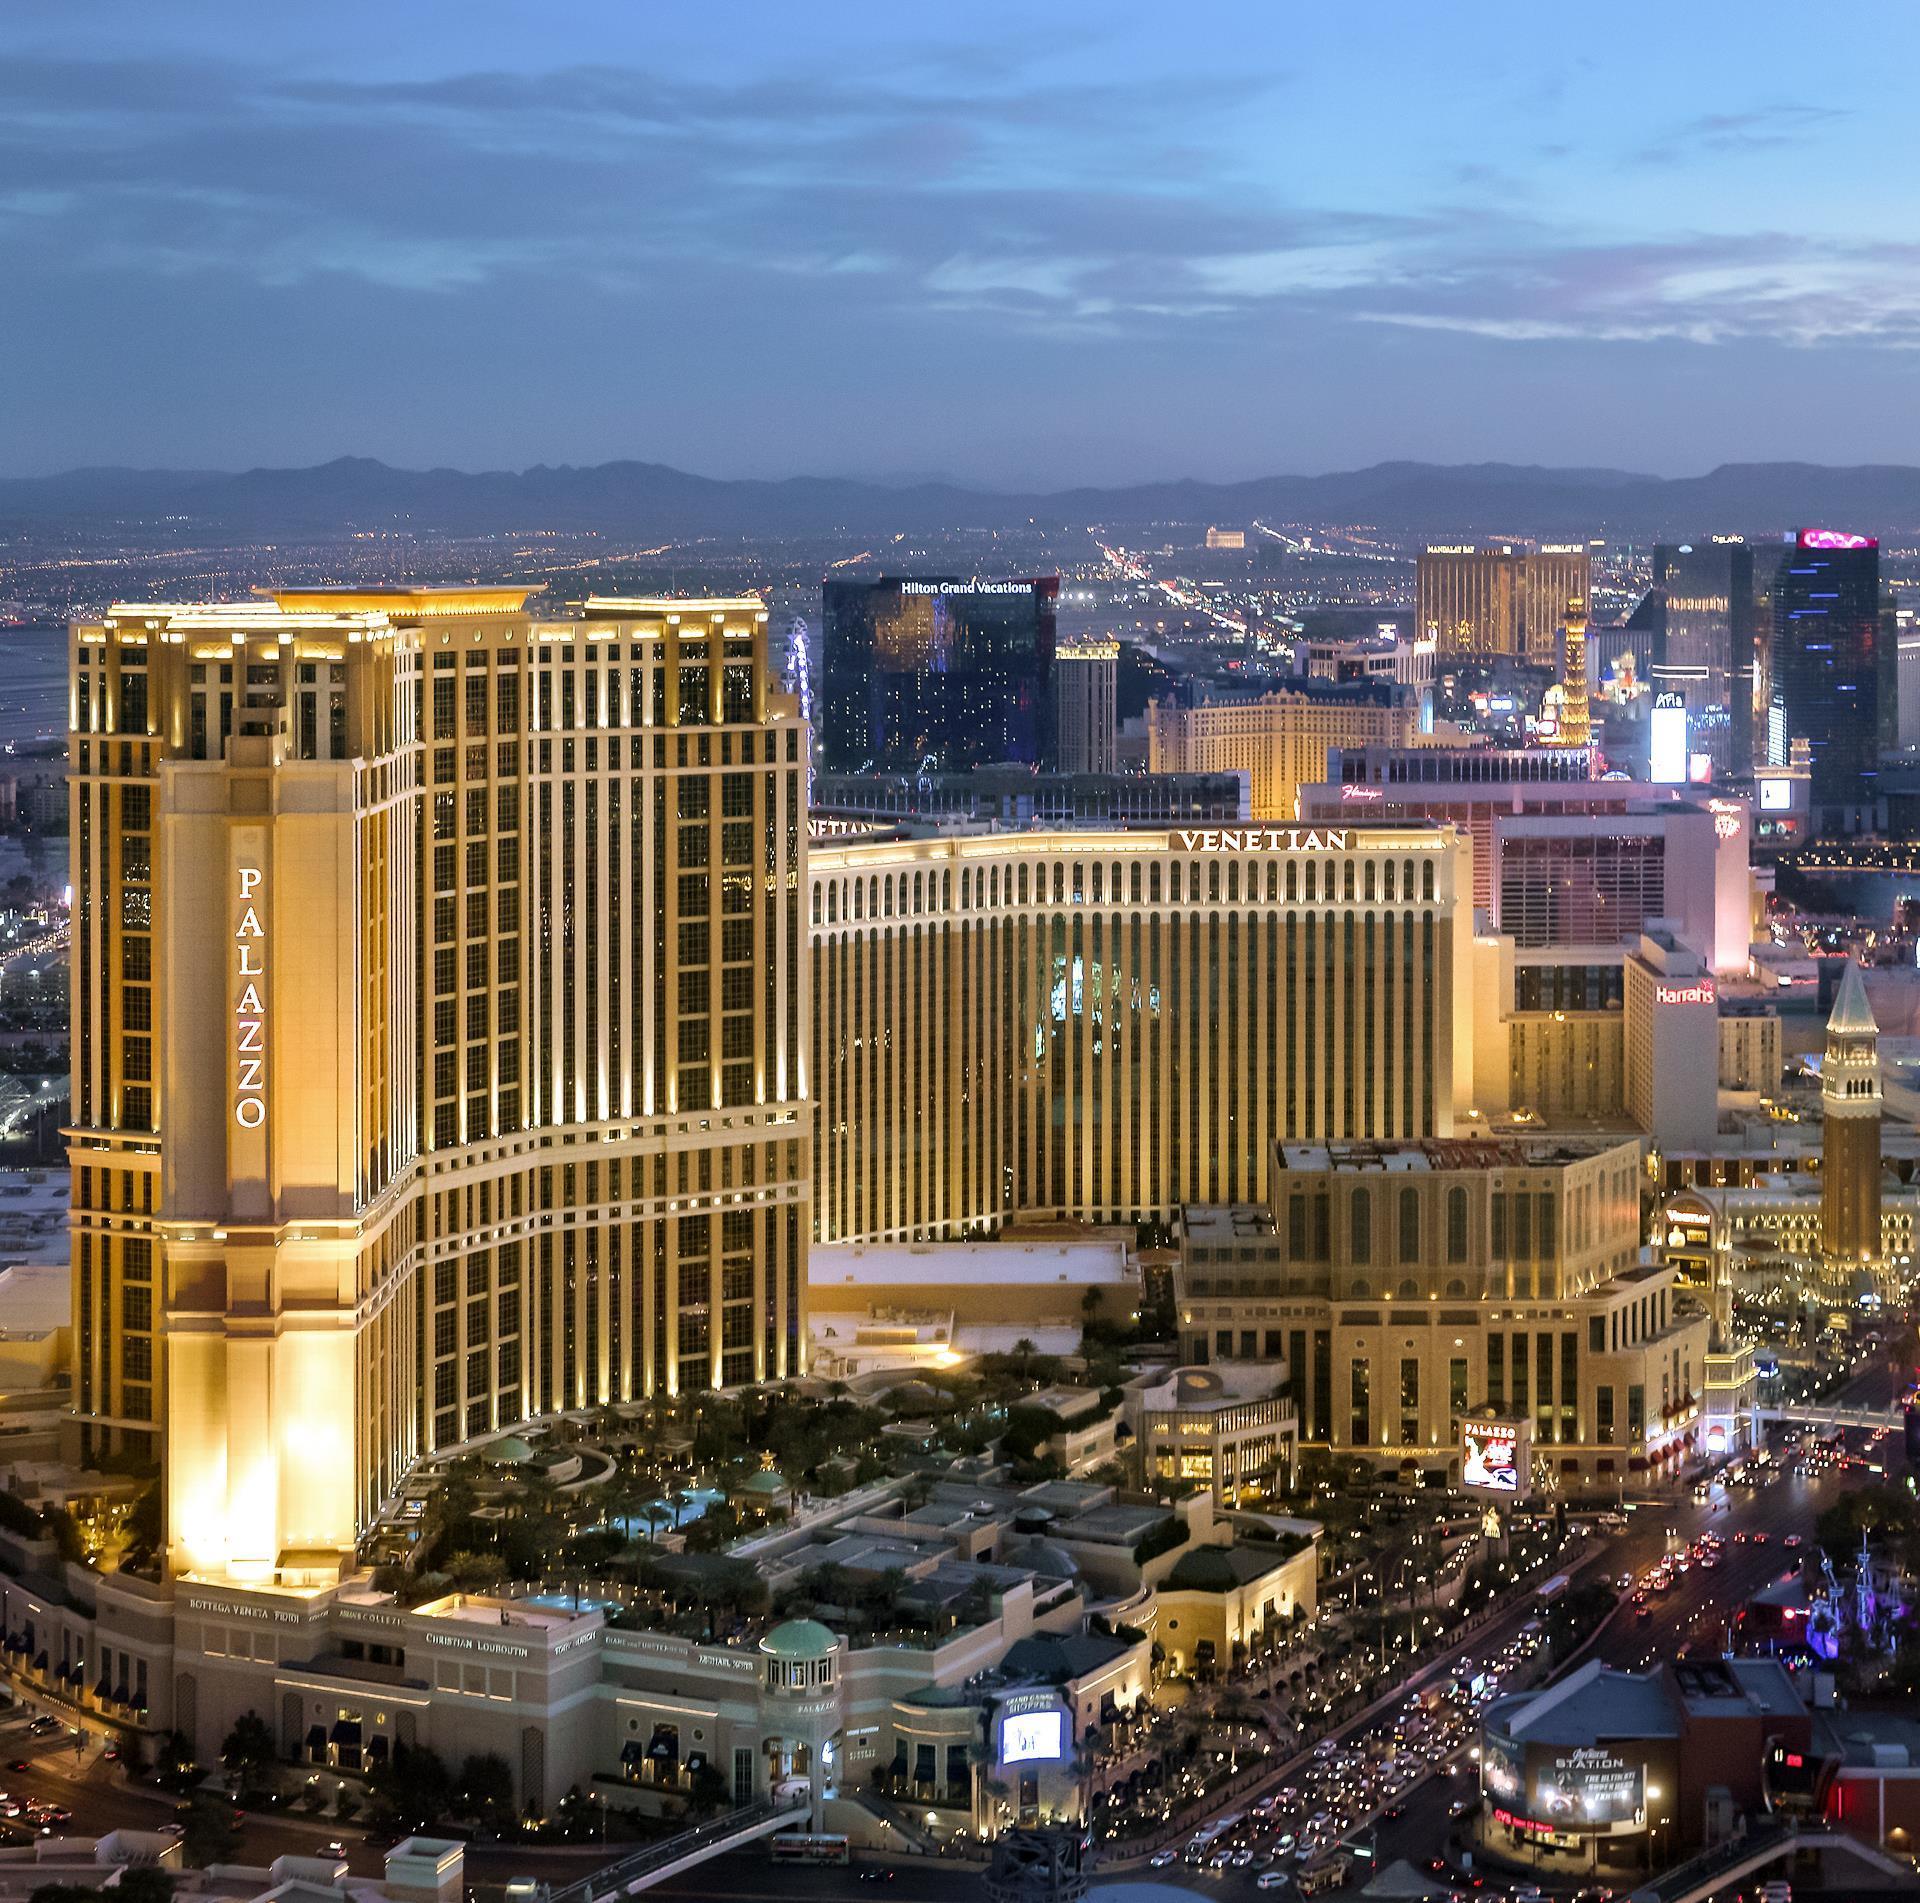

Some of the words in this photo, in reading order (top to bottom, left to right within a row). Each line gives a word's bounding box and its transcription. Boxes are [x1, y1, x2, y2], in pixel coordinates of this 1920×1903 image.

[1712, 535, 1744, 544] DELANO
[1427, 545, 1462, 554] MANDALAY
[901, 582, 938, 594] Hilton
[940, 581, 975, 594] Grand
[977, 581, 1032, 594] Vacations
[1177, 829, 1349, 852] VENETIAN
[235, 868, 266, 1128] PALAZZO
[1464, 1422, 1517, 1440] PALAZZO
[190, 1599, 231, 1614] BOTTEGA
[233, 1604, 269, 1619] VENETA
[426, 1633, 473, 1649] CHRISTIAN
[477, 1640, 528, 1657] LOUBOUTIN
[699, 1654, 731, 1668] MICHAEL
[798, 1701, 835, 1713] PALAZZO
[1585, 1774, 1600, 1783] THE
